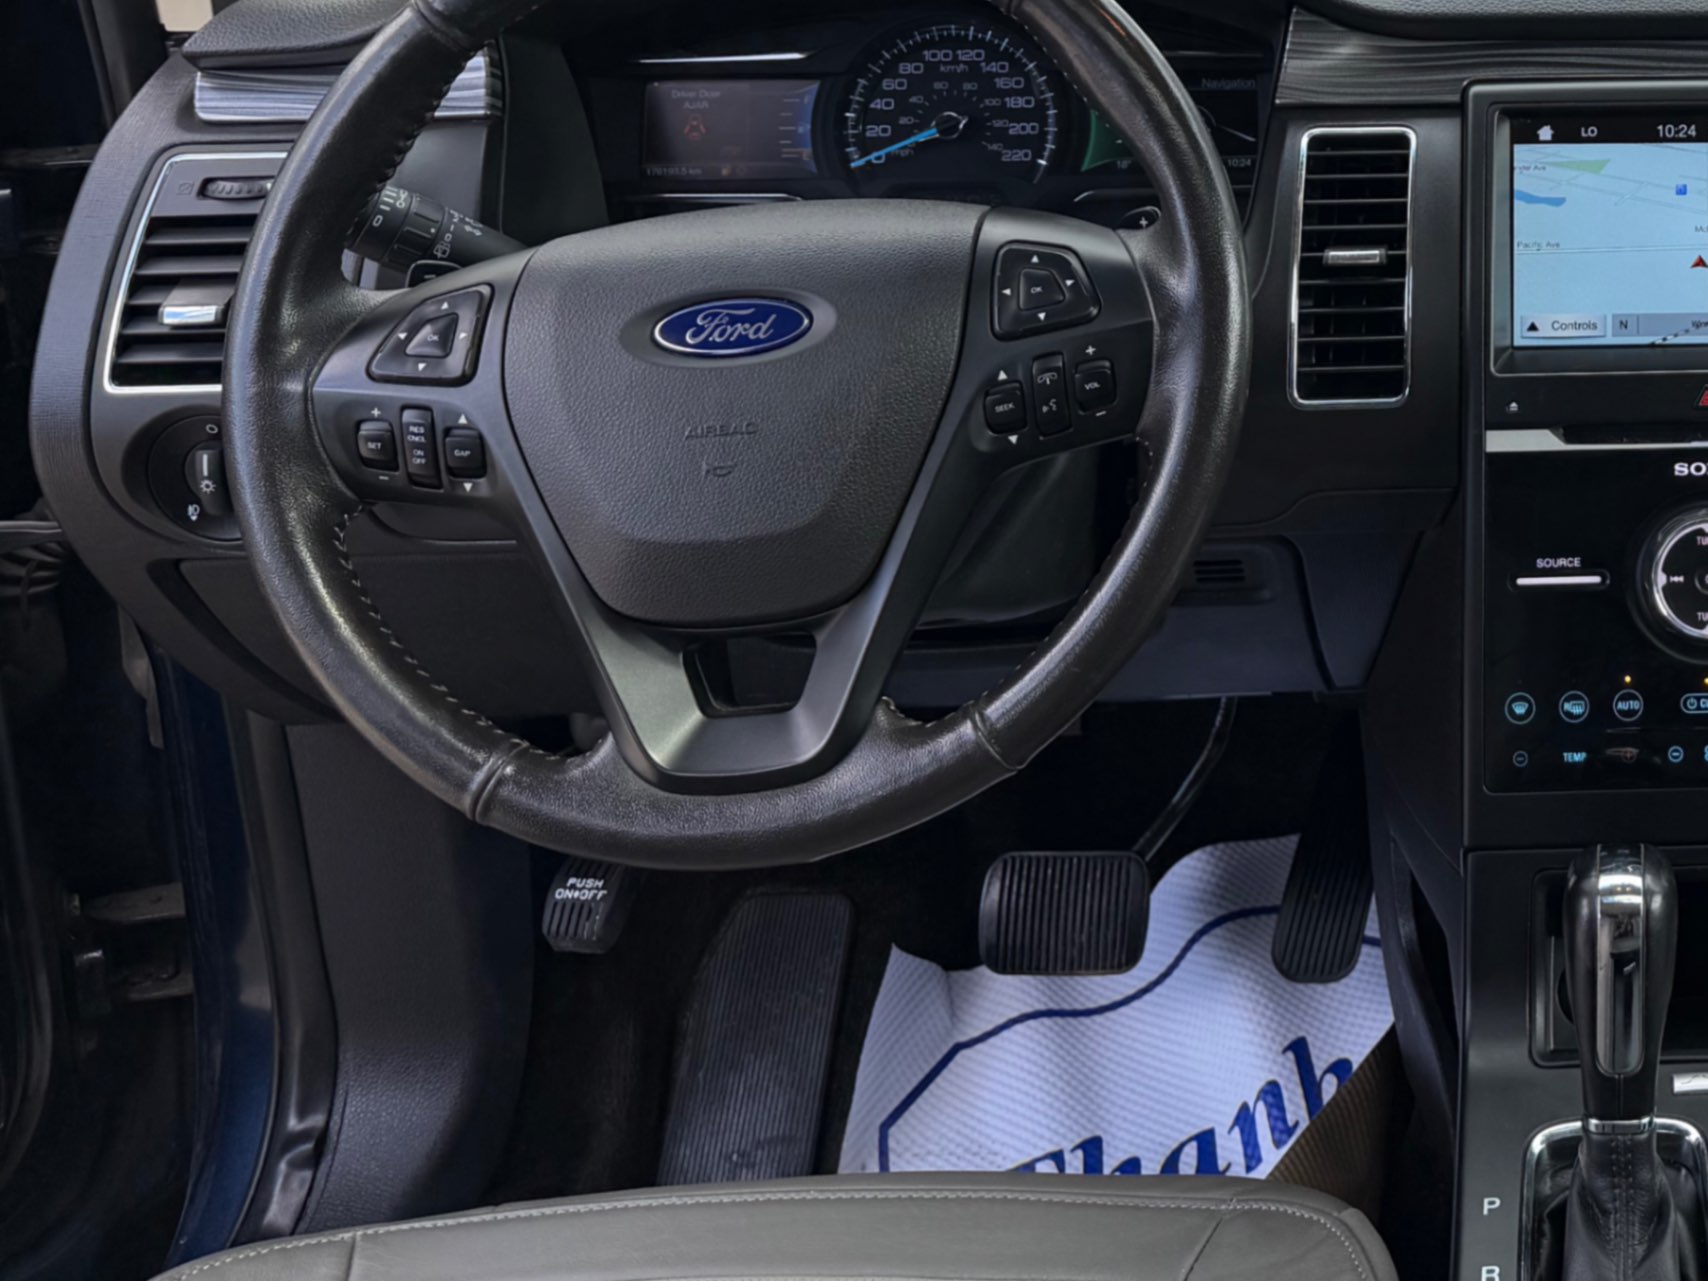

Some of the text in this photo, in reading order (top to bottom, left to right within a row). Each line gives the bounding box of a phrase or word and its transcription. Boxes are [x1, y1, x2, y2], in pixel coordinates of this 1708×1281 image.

[923, 50, 953, 62] 100
[956, 49, 985, 62] 120
[898, 62, 924, 75] 80
[940, 62, 969, 74] km/h
[980, 61, 1009, 74] 140
[882, 78, 907, 91] 60
[994, 77, 1024, 89] 160
[1201, 78, 1256, 90] Navigation
[869, 98, 895, 110] 40
[1004, 96, 1035, 108] 180
[865, 124, 892, 137] 20
[1008, 122, 1039, 135] 200
[1581, 127, 1598, 137] LO
[1656, 125, 1697, 138] 10:24
[1001, 149, 1032, 162] 220
[1227, 158, 1252, 167] 10:24
[1030, 285, 1042, 294] OK
[685, 307, 777, 345] Ford
[1551, 320, 1598, 332] Controls
[1619, 320, 1629, 330] N
[427, 333, 439, 342] OK
[1084, 381, 1100, 390] VOL
[995, 402, 1015, 412] SEEK
[409, 425, 425, 434] RES
[367, 441, 382, 450] SET
[454, 448, 471, 457] GAP
[1536, 557, 1582, 569] SOURCE
[1617, 700, 1641, 711] AUTO
[1563, 752, 1587, 763] TEMP
[566, 877, 605, 888] PUSH
[1482, 1197, 1501, 1216] P
[1481, 1266, 1500, 1281] R
